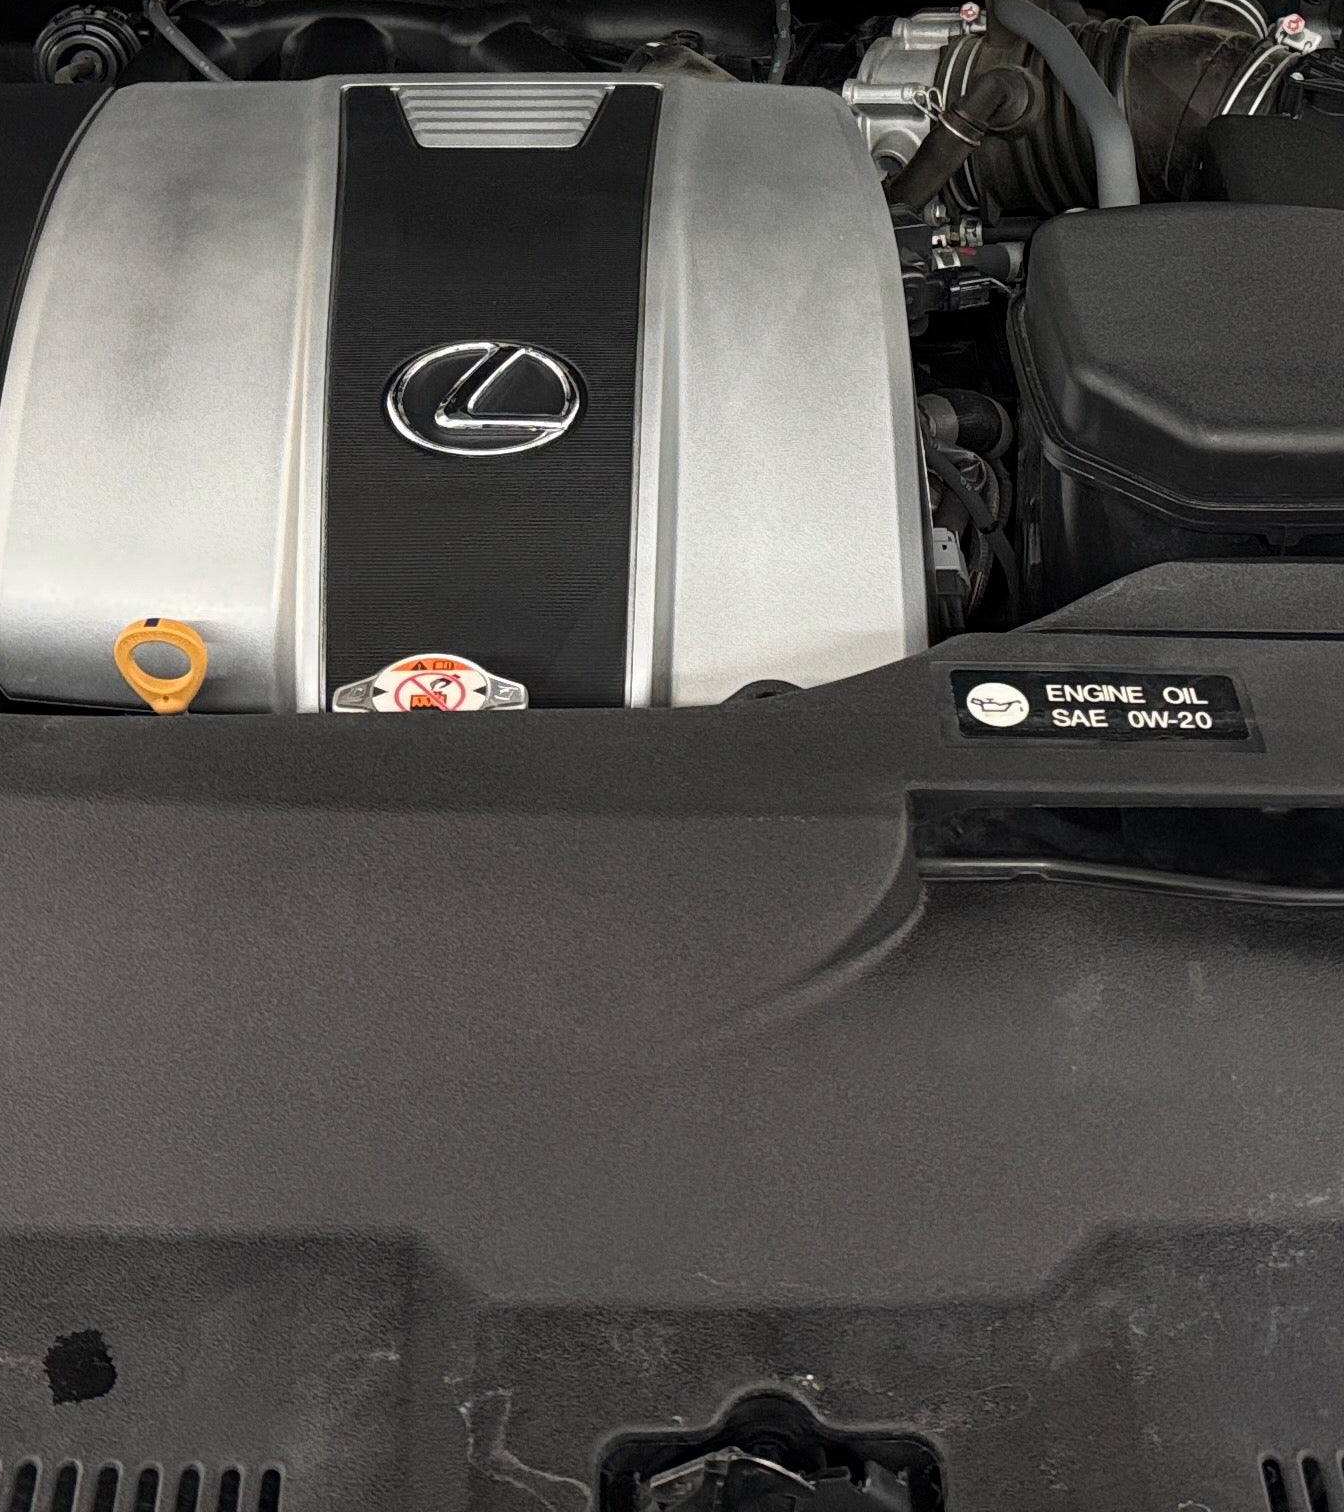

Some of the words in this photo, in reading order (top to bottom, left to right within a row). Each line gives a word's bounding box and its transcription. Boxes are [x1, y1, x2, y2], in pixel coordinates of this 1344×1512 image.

[1045, 684, 1146, 704] ENGINE
[1162, 686, 1209, 705] OIL
[1051, 708, 1109, 728] SAE
[1128, 710, 1213, 730] 0W-20
